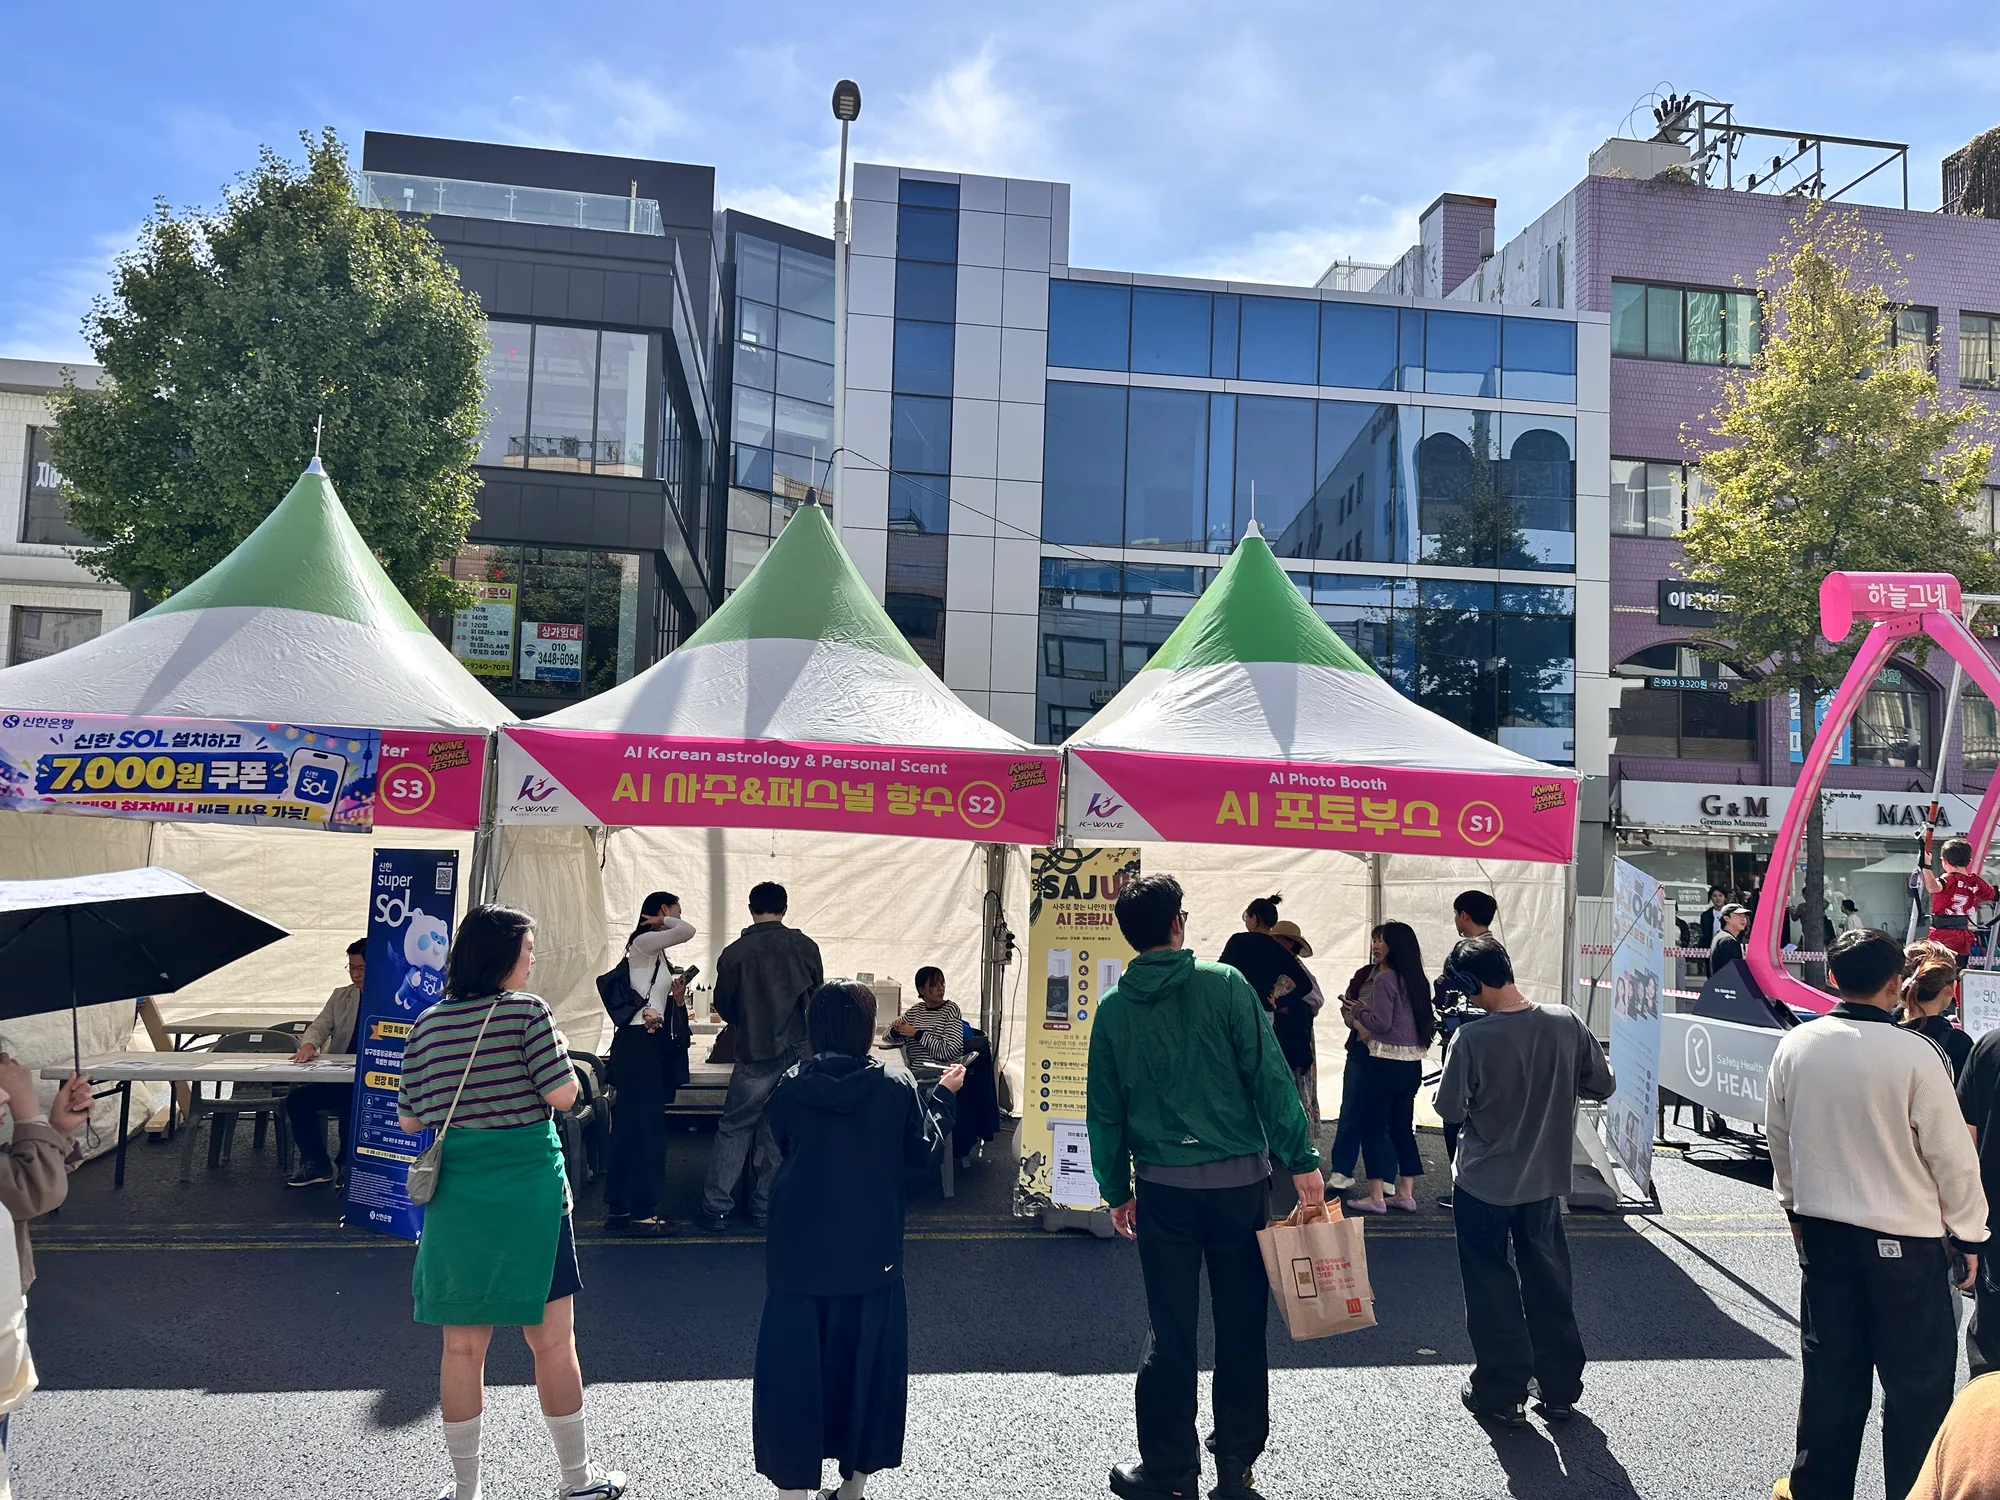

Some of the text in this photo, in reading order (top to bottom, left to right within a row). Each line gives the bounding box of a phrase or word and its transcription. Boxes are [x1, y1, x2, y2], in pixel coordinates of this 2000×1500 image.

[1867, 583, 1947, 609] 하늘그네
[541, 626, 578, 639] 상가임대
[551, 643, 567, 652] 010
[537, 651, 579, 666] 3448-6094
[23, 716, 74, 730] 신한은행
[74, 729, 241, 750] 신한 SOL 설치하고
[382, 743, 409, 758] ter
[427, 740, 465, 756] KWAVE
[432, 750, 468, 764] DANCE
[624, 746, 948, 775] AI Korean astrology & Personal Scent
[429, 758, 471, 773] FESTIVAL
[1008, 760, 1042, 776] KWAVE
[50, 755, 268, 793] 7,000원 쿠폰
[1013, 770, 1045, 783] DANCE
[1269, 772, 1387, 791] AI Photo Booth
[300, 778, 329, 796] SOL
[392, 779, 423, 799] S3
[1009, 776, 1048, 791] FESTIVAL
[1531, 783, 1561, 798] KWAVE
[611, 772, 955, 818] AI 사주&퍼스널 향수
[1535, 791, 1565, 804] DANCE
[1848, 793, 1862, 801] shop
[510, 805, 559, 813] K-WAVE
[968, 795, 995, 814] S2
[1532, 798, 1567, 813] FESTIVAL
[1215, 790, 1442, 838] AI 포토부스
[1877, 803, 1952, 828] MAYA
[1079, 821, 1124, 829] K-WAVE
[1470, 814, 1493, 833] S1
[1700, 818, 1733, 827] Gremito
[378, 862, 392, 872] 신한
[377, 874, 413, 891] super
[374, 889, 414, 928] SOL
[1052, 903, 1071, 912] 사주로
[1073, 903, 1086, 911] 찾는
[1087, 903, 1107, 912] 나만의
[1056, 912, 1113, 926] AI 조향사
[1717, 1054, 1764, 1073] Safety Health
[374, 1075, 386, 1086] 현장
